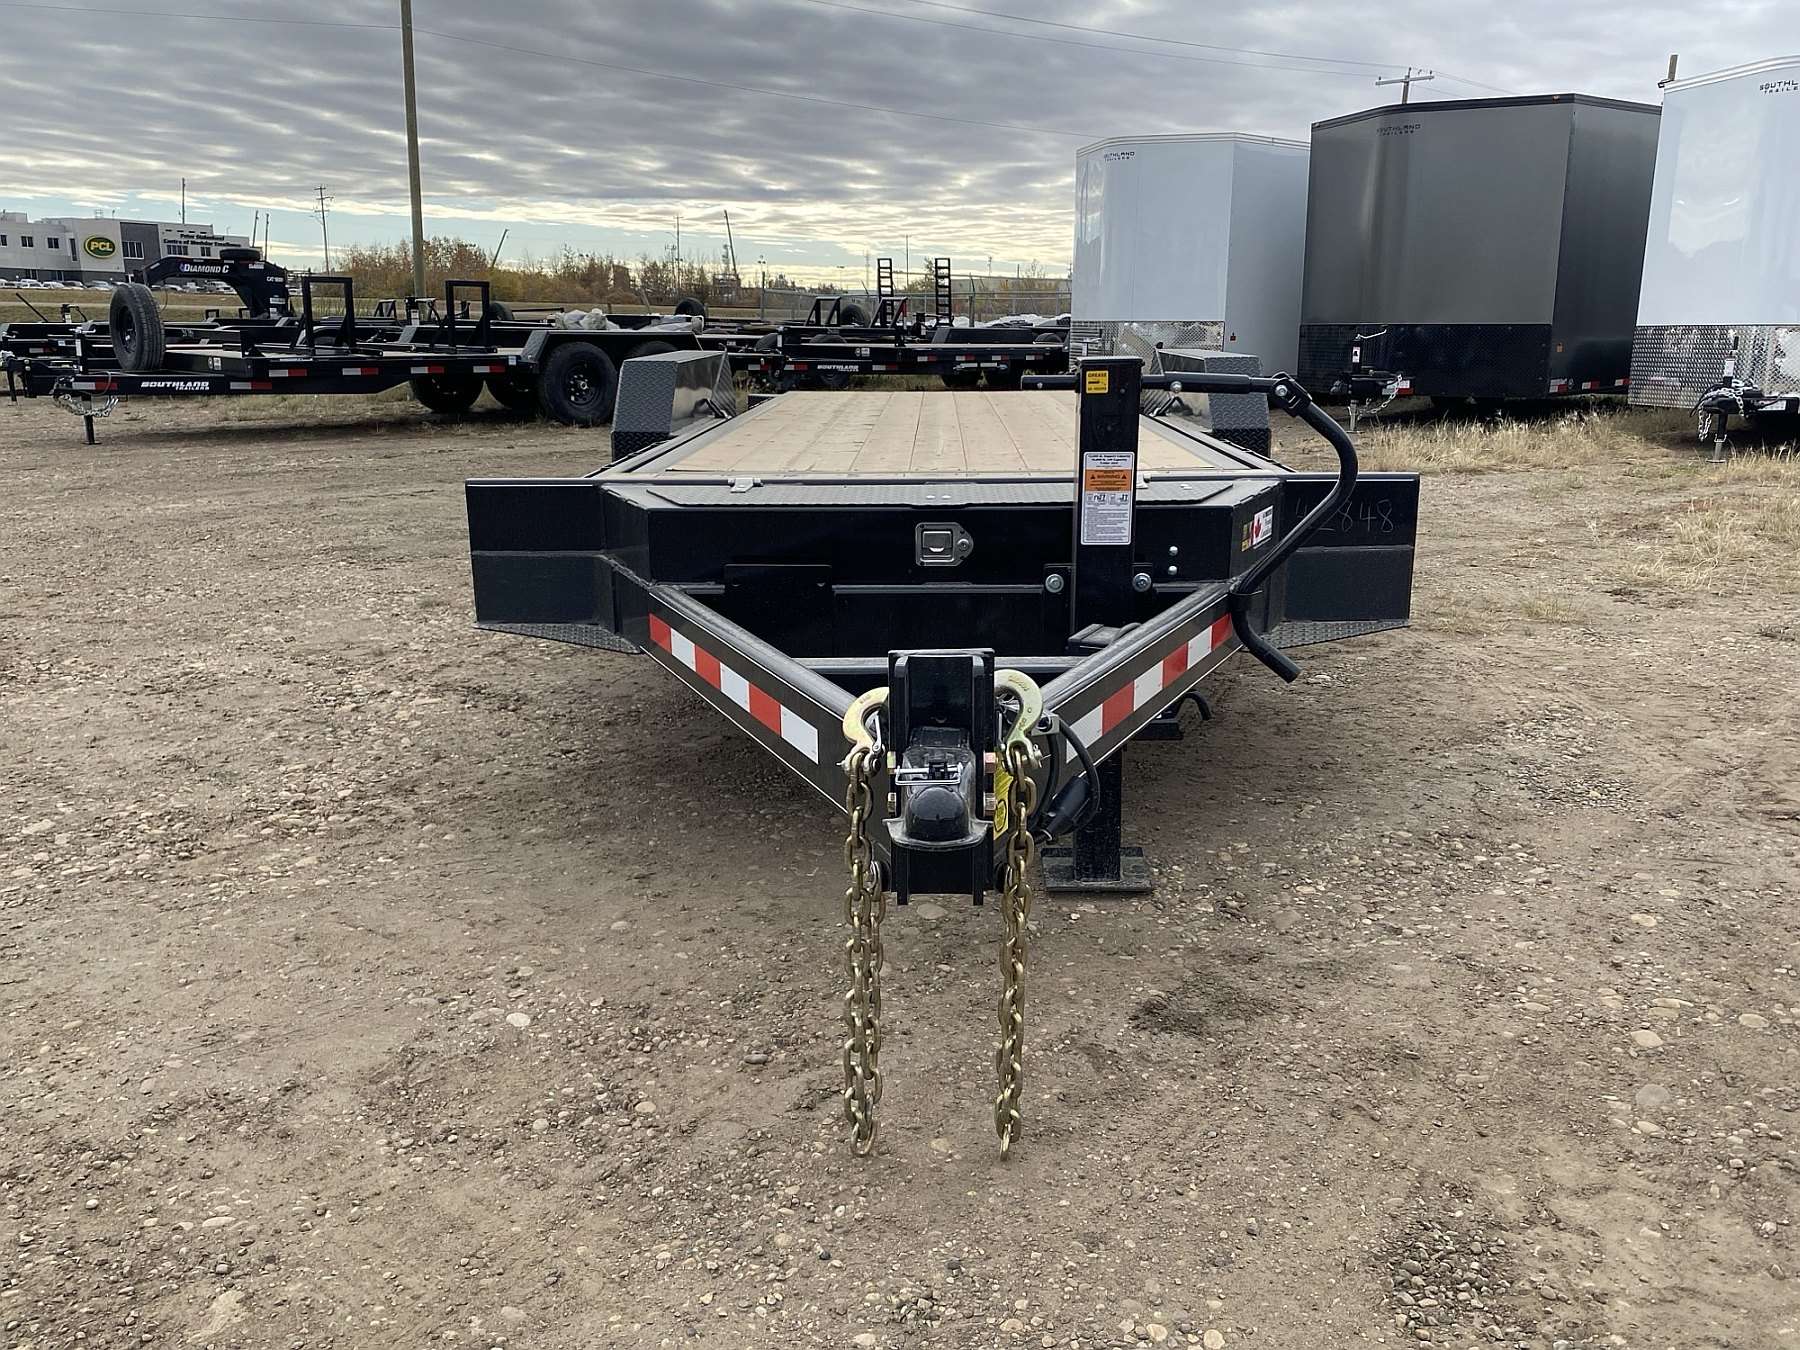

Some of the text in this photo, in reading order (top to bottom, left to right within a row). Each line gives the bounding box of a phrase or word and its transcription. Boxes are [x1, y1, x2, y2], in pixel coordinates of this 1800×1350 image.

[90, 241, 113, 252] PCL
[184, 263, 230, 273] DIAMOND C
[1296, 498, 1394, 533] 4848
